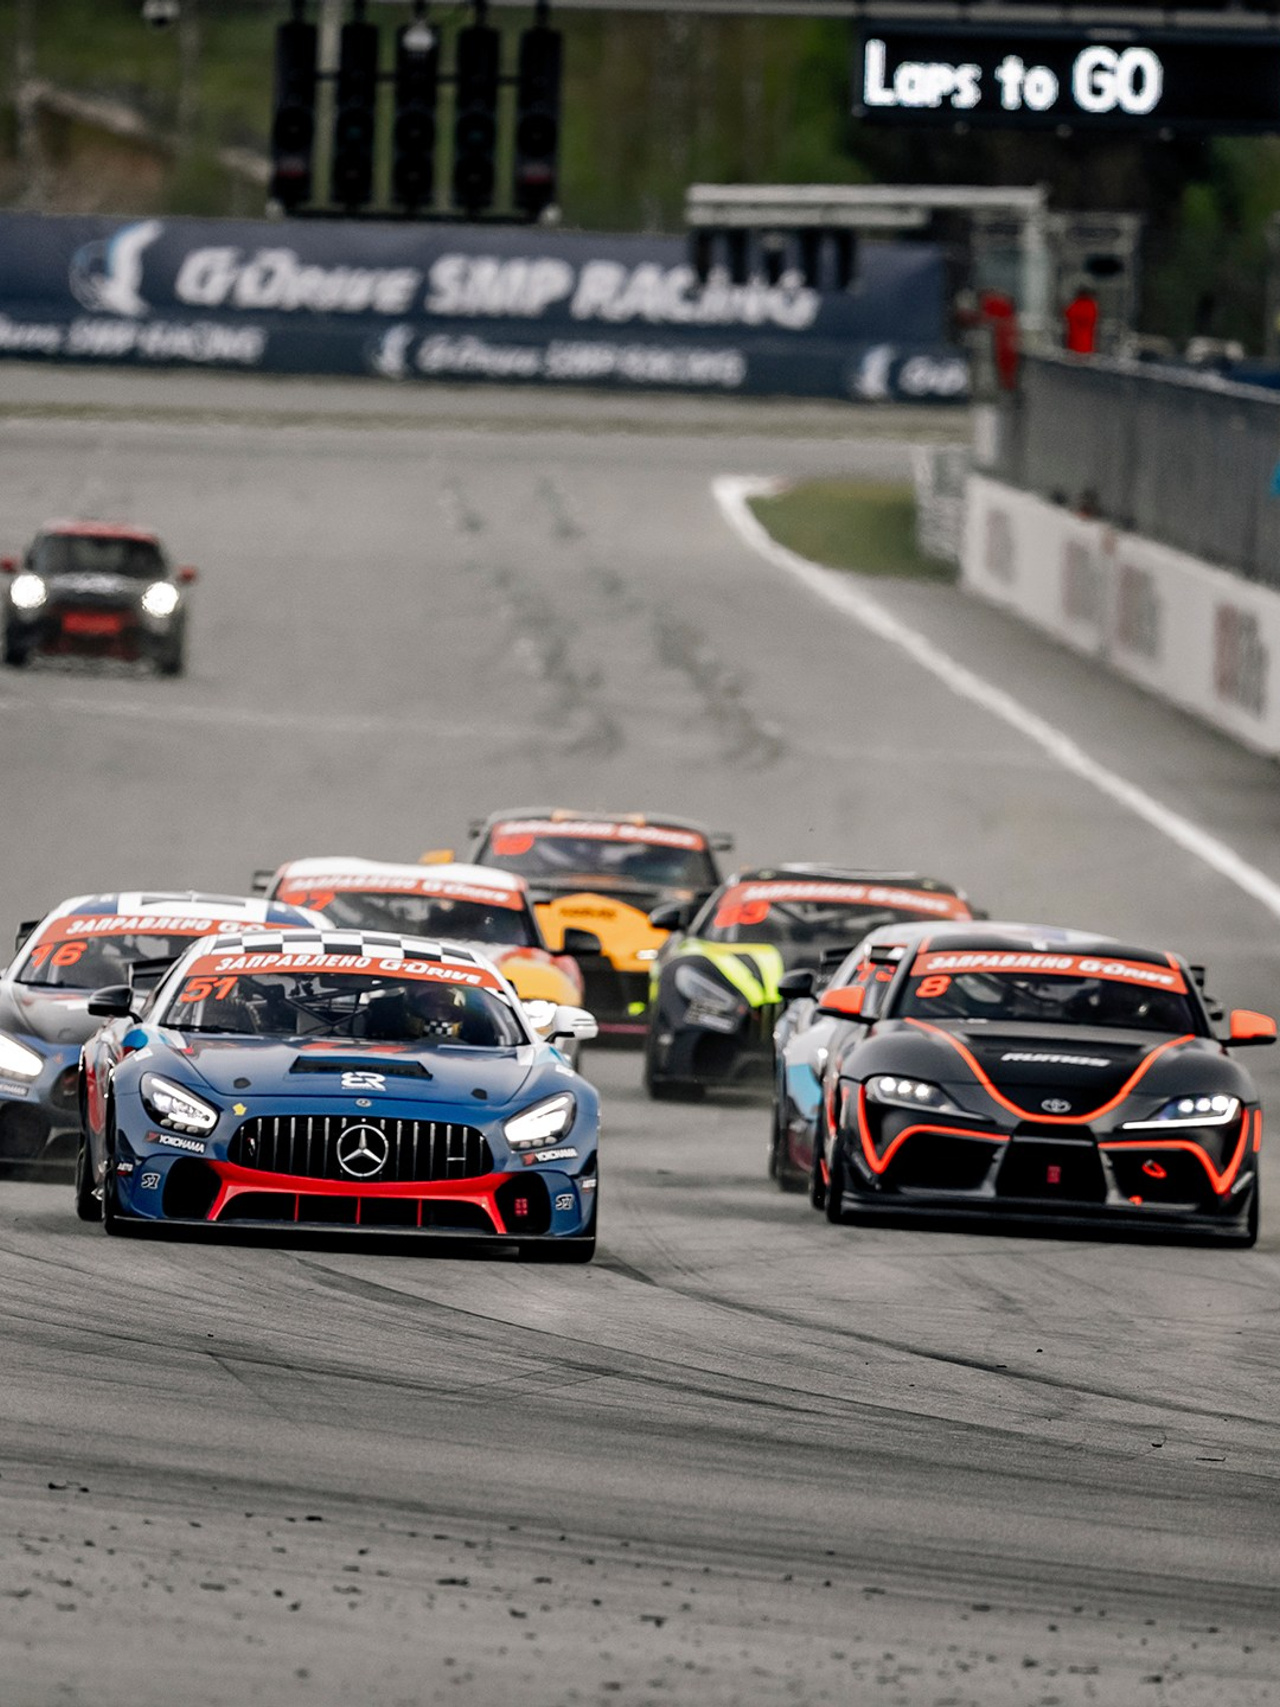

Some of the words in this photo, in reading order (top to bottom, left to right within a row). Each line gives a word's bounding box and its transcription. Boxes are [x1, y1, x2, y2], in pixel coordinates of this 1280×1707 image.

[864, 38, 982, 108] Laps
[995, 54, 1060, 111] to
[1072, 45, 1164, 115] GO
[424, 252, 573, 318] SMP
[66, 917, 213, 935] ЗАПРАВЛЕНО
[30, 942, 88, 967] 16
[215, 954, 370, 971] ЗАПРАВЛЕНО
[926, 954, 1074, 971] ЗАПРАВЛЕНО
[180, 976, 238, 1003] 51
[915, 975, 952, 998] 8
[158, 1134, 205, 1154] YOKOHAMA
[534, 1147, 579, 1162] YOKOHAMA
